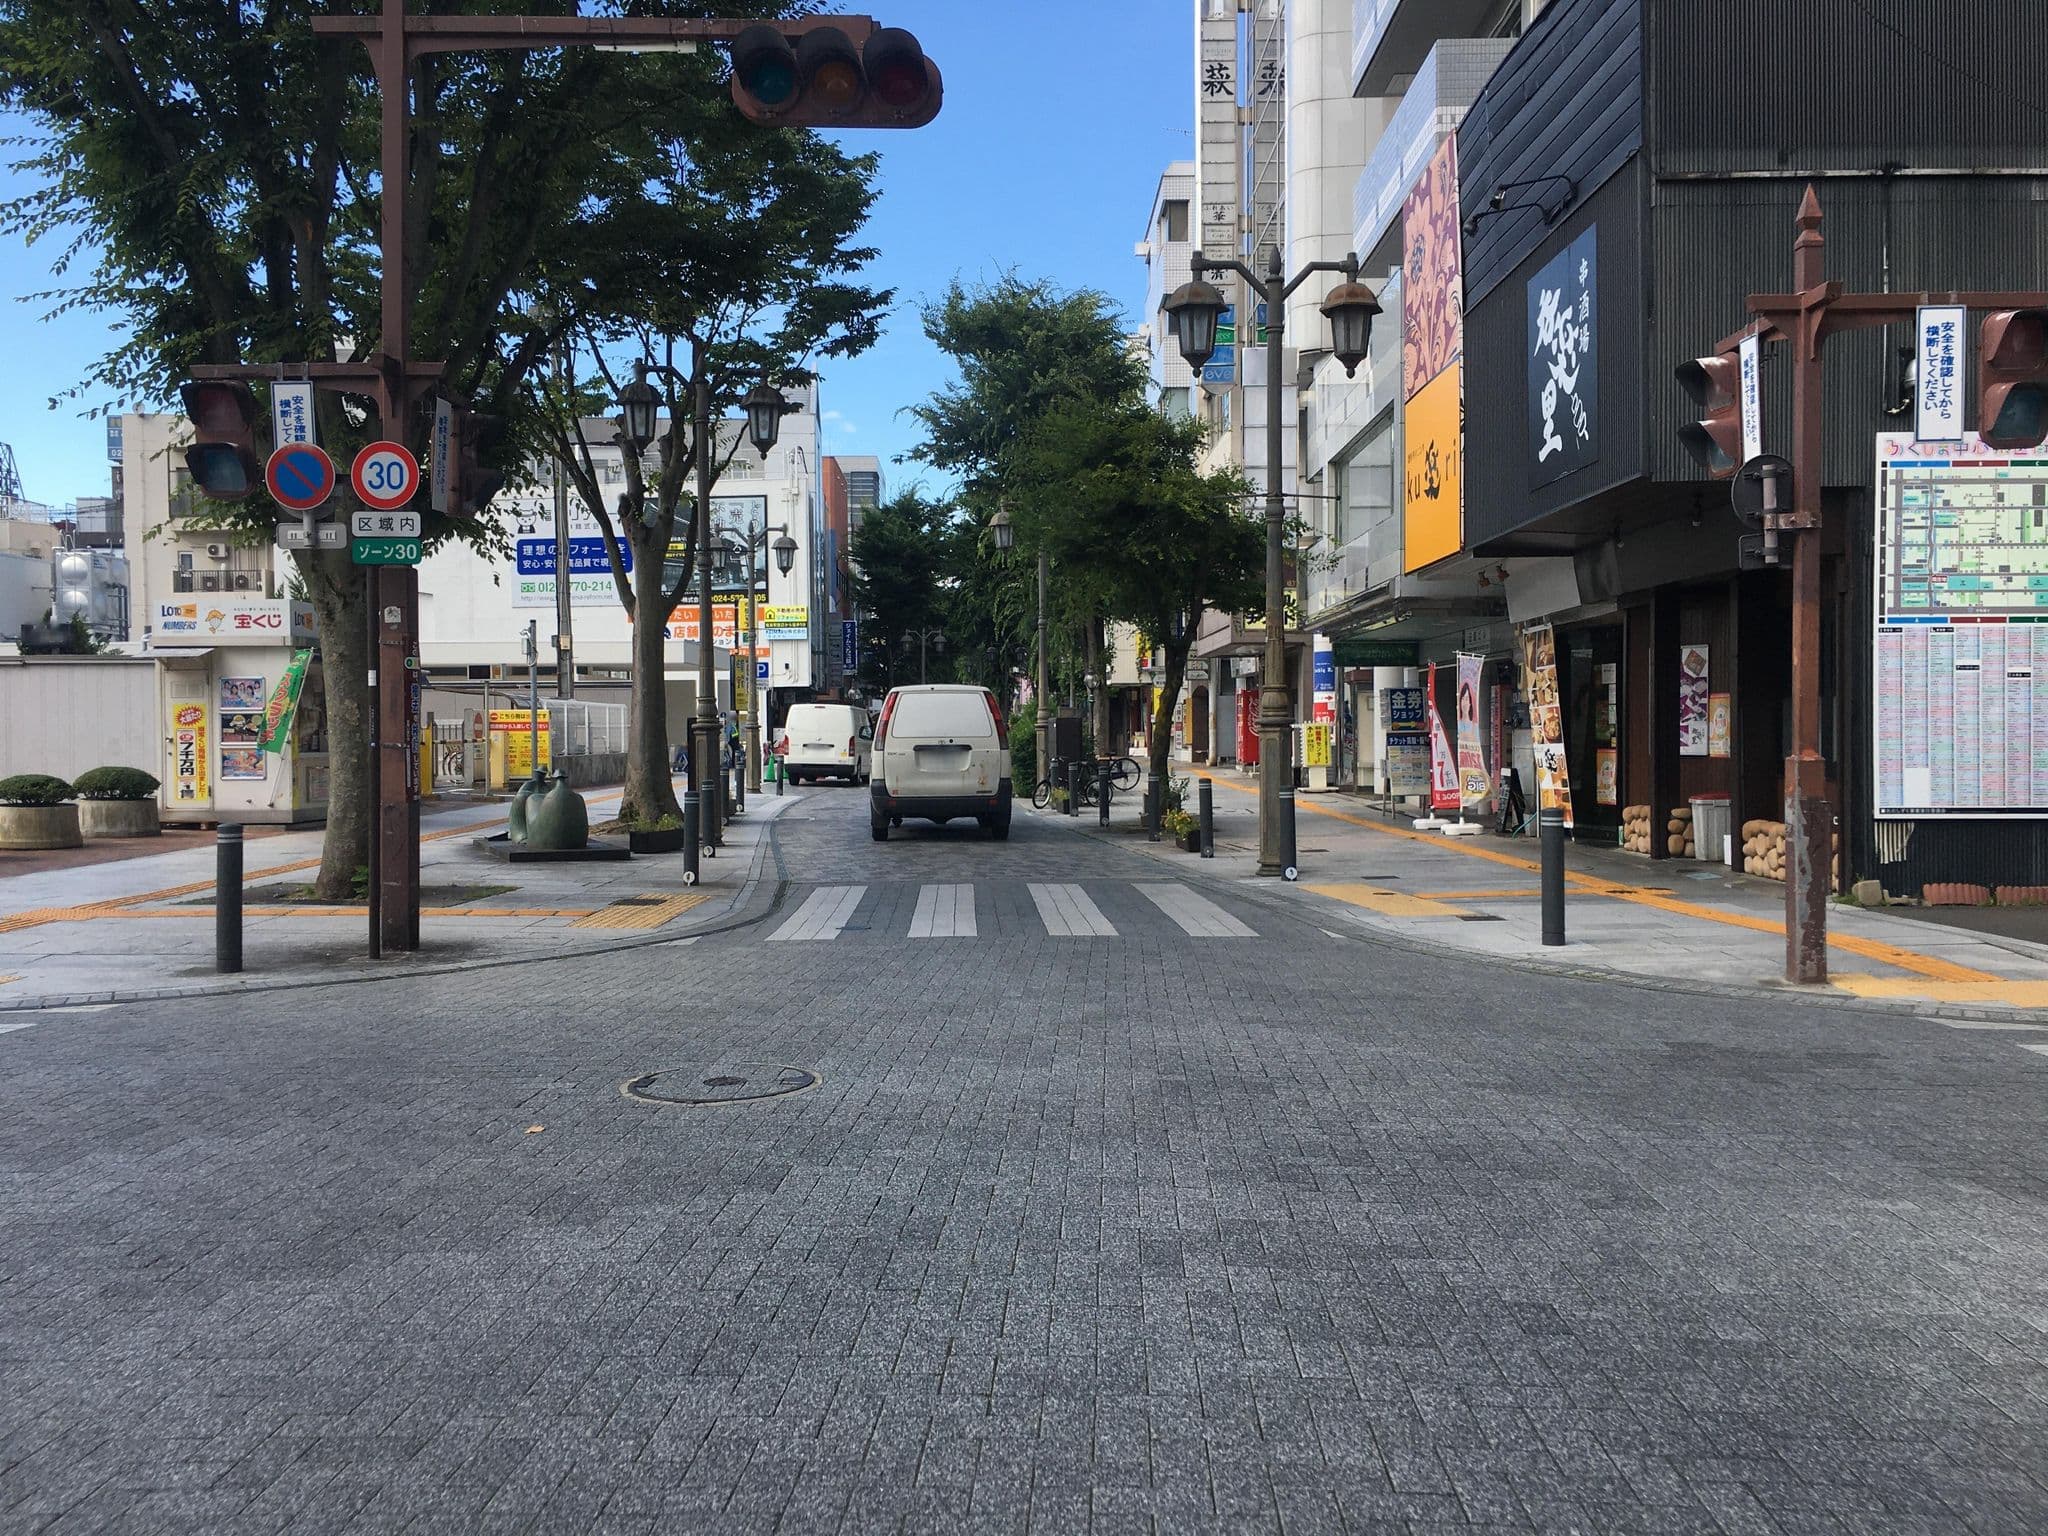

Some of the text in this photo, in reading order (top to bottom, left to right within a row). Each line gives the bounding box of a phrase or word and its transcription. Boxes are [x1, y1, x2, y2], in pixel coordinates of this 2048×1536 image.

[1578, 257, 1590, 353] 串酒場
[1924, 325, 1941, 411] 横断してください
[1939, 321, 1955, 420] 安全を確認してから
[368, 461, 404, 490] 30
[358, 517, 415, 532] 区域内
[360, 544, 417, 560] ゾーン30
[162, 621, 198, 630] NUMBERS
[234, 614, 282, 629] 宝くじ
[757, 664, 766, 677] P
[1391, 691, 1422, 709] 金券
[1392, 710, 1422, 719] ショップ
